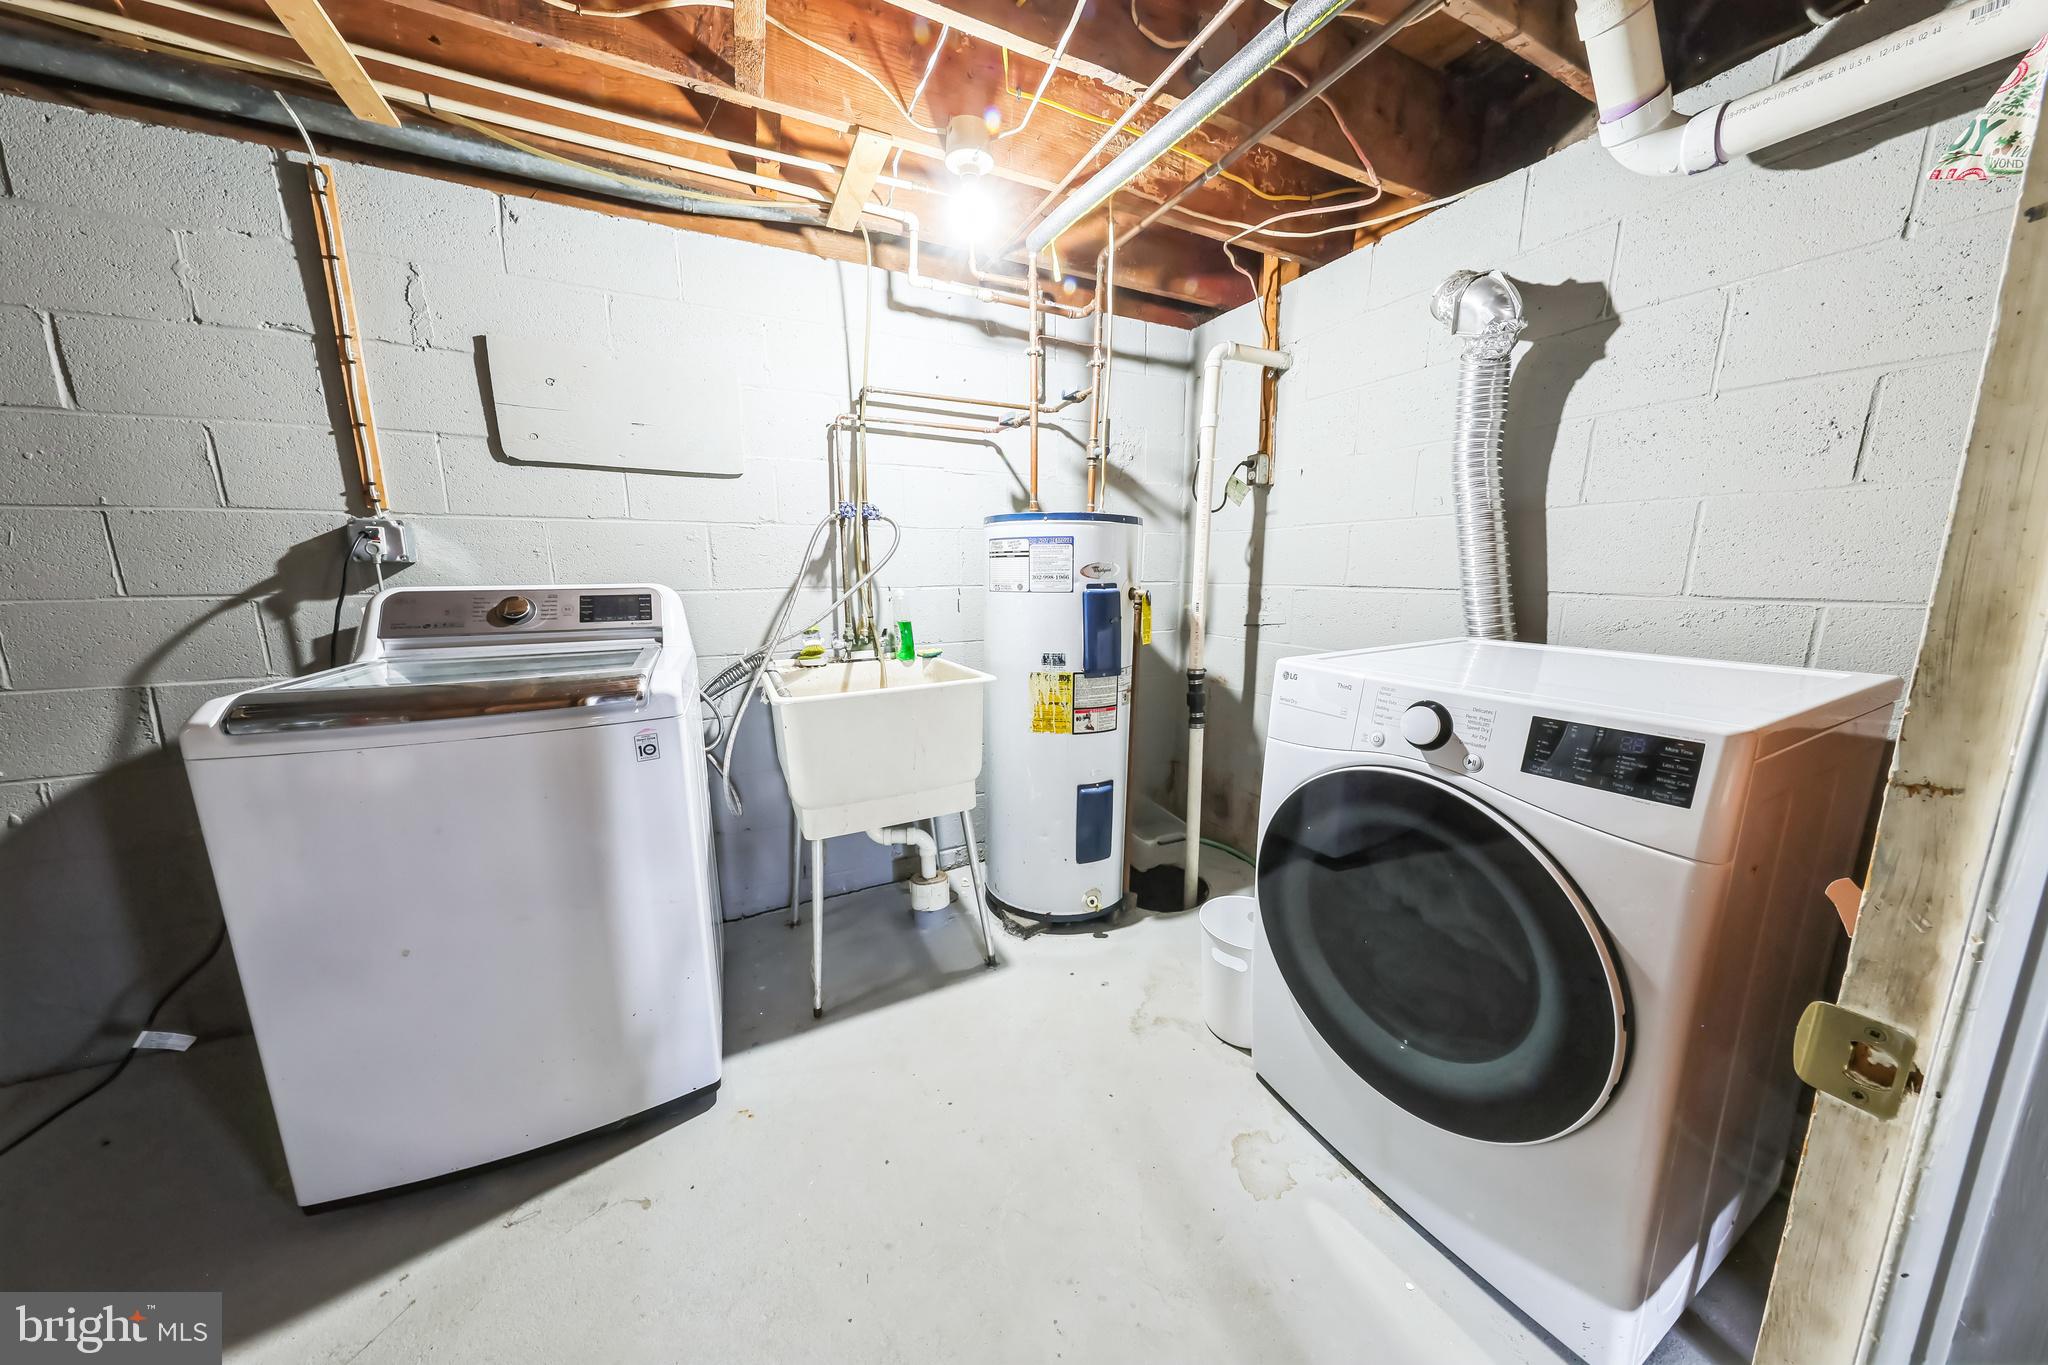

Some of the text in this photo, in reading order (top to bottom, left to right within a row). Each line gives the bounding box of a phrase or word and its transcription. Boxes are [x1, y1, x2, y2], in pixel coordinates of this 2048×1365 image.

[1818, 71, 1834, 83] MADE
[1838, 66, 1847, 75] IN
[1337, 682, 1352, 690] ThinQ
[1472, 706, 1493, 715] Delicates
[638, 744, 656, 757] 10
